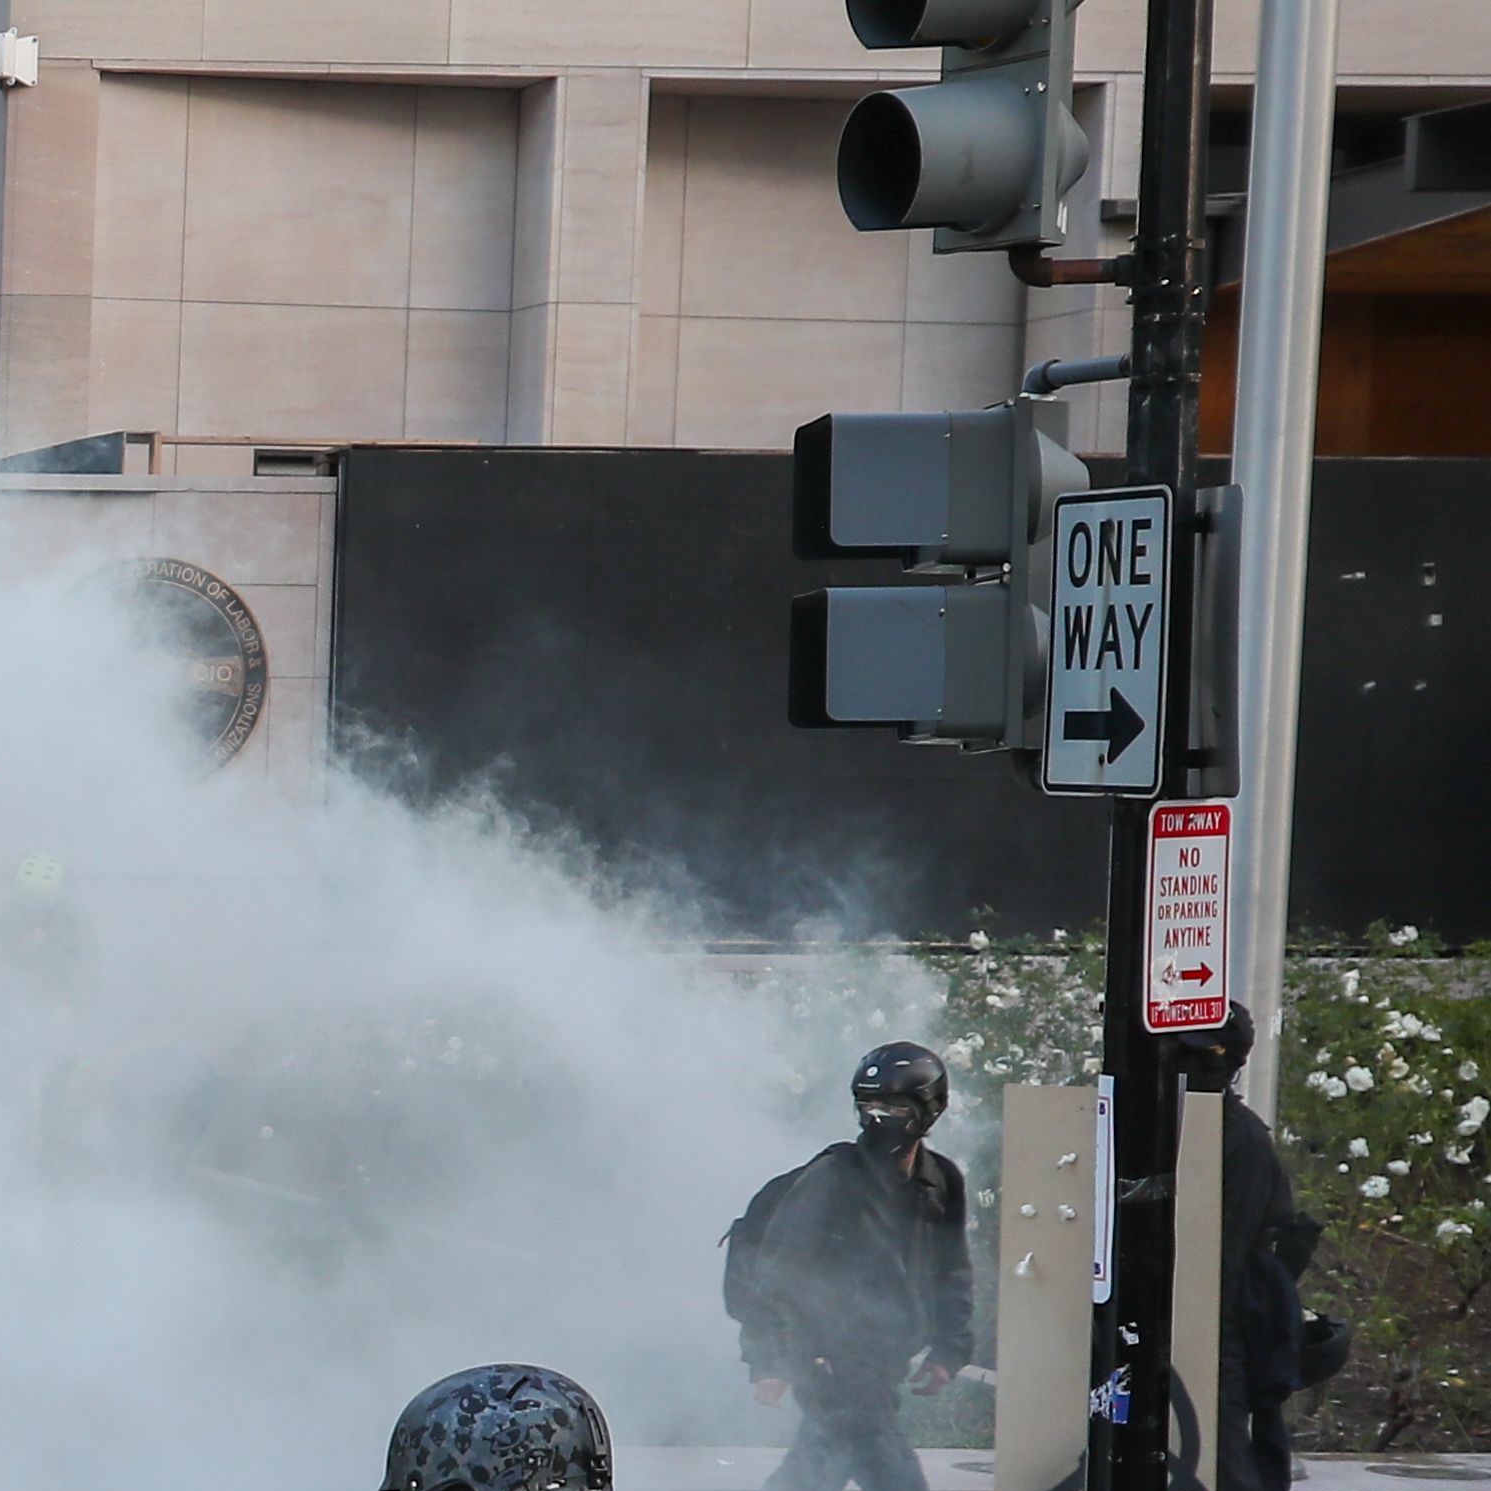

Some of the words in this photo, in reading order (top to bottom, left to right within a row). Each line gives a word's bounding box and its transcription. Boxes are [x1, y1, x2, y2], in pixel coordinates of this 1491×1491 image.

[1069, 519, 1152, 588] ONE
[207, 581, 230, 601] OF
[225, 599, 260, 654] LABOR
[1064, 604, 1154, 670] WAY
[193, 665, 232, 682] CIO
[1161, 813, 1183, 832] TOW
[1187, 812, 1222, 831] AWAY
[1179, 848, 1201, 868] NO
[1160, 874, 1218, 897] STANDING
[1158, 904, 1172, 921] OR
[1173, 900, 1218, 920] PARKING
[1164, 925, 1212, 949] ANYTIME
[1190, 1003, 1208, 1020] CALL
